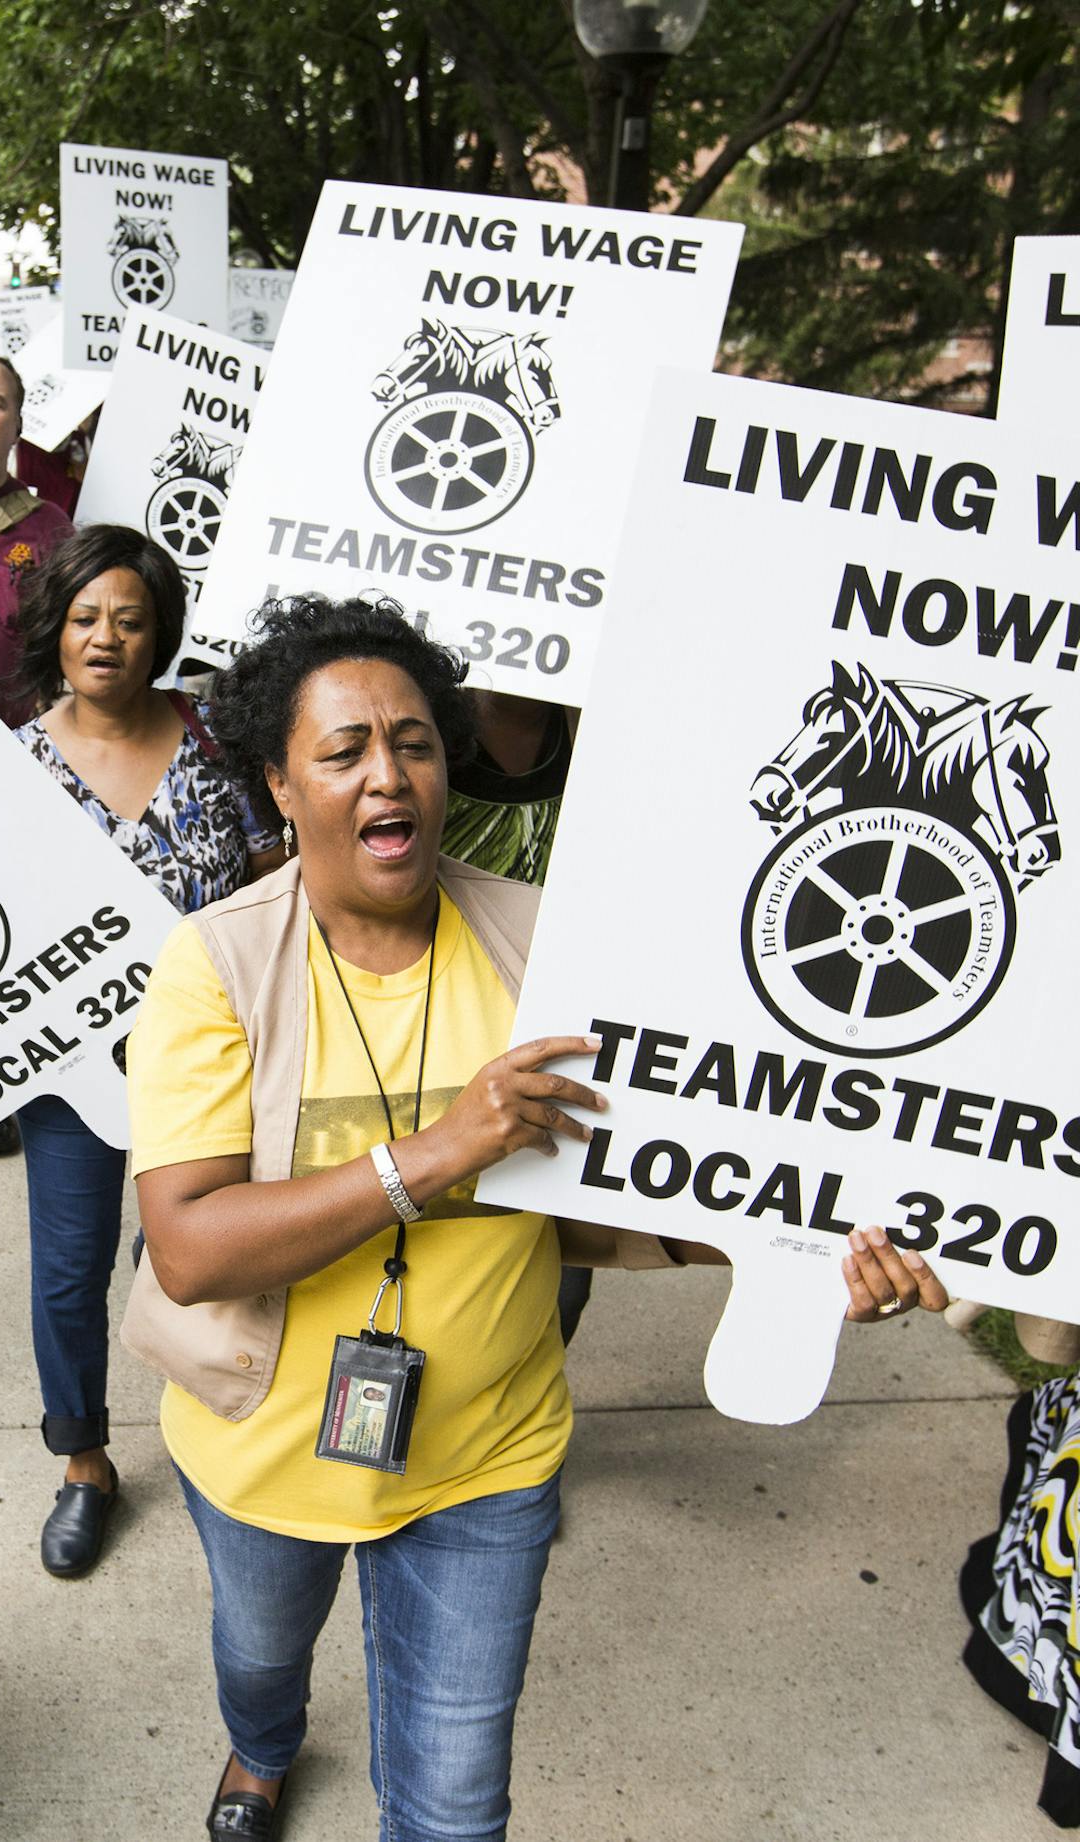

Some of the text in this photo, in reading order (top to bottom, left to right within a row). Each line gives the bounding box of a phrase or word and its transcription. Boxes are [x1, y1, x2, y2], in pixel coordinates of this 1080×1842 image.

[74, 156, 216, 187] LIVING WAGE
[115, 190, 173, 211] NOW!
[337, 203, 703, 274] LIVING WAGE
[421, 270, 575, 319] NOW!
[136, 324, 241, 384] LIVING
[376, 406, 420, 479] International
[424, 396, 508, 424] Brotherhood
[497, 440, 523, 499] Teamsters
[683, 416, 998, 536] LIVING
[267, 516, 607, 608] TEAMSTERS
[460, 620, 571, 676] 320
[831, 563, 1080, 672] NOW!
[760, 814, 998, 1002] International Brotherhood of Teamsters
[76, 961, 152, 1029] 320
[580, 1127, 1058, 1277] LOCAL 320
